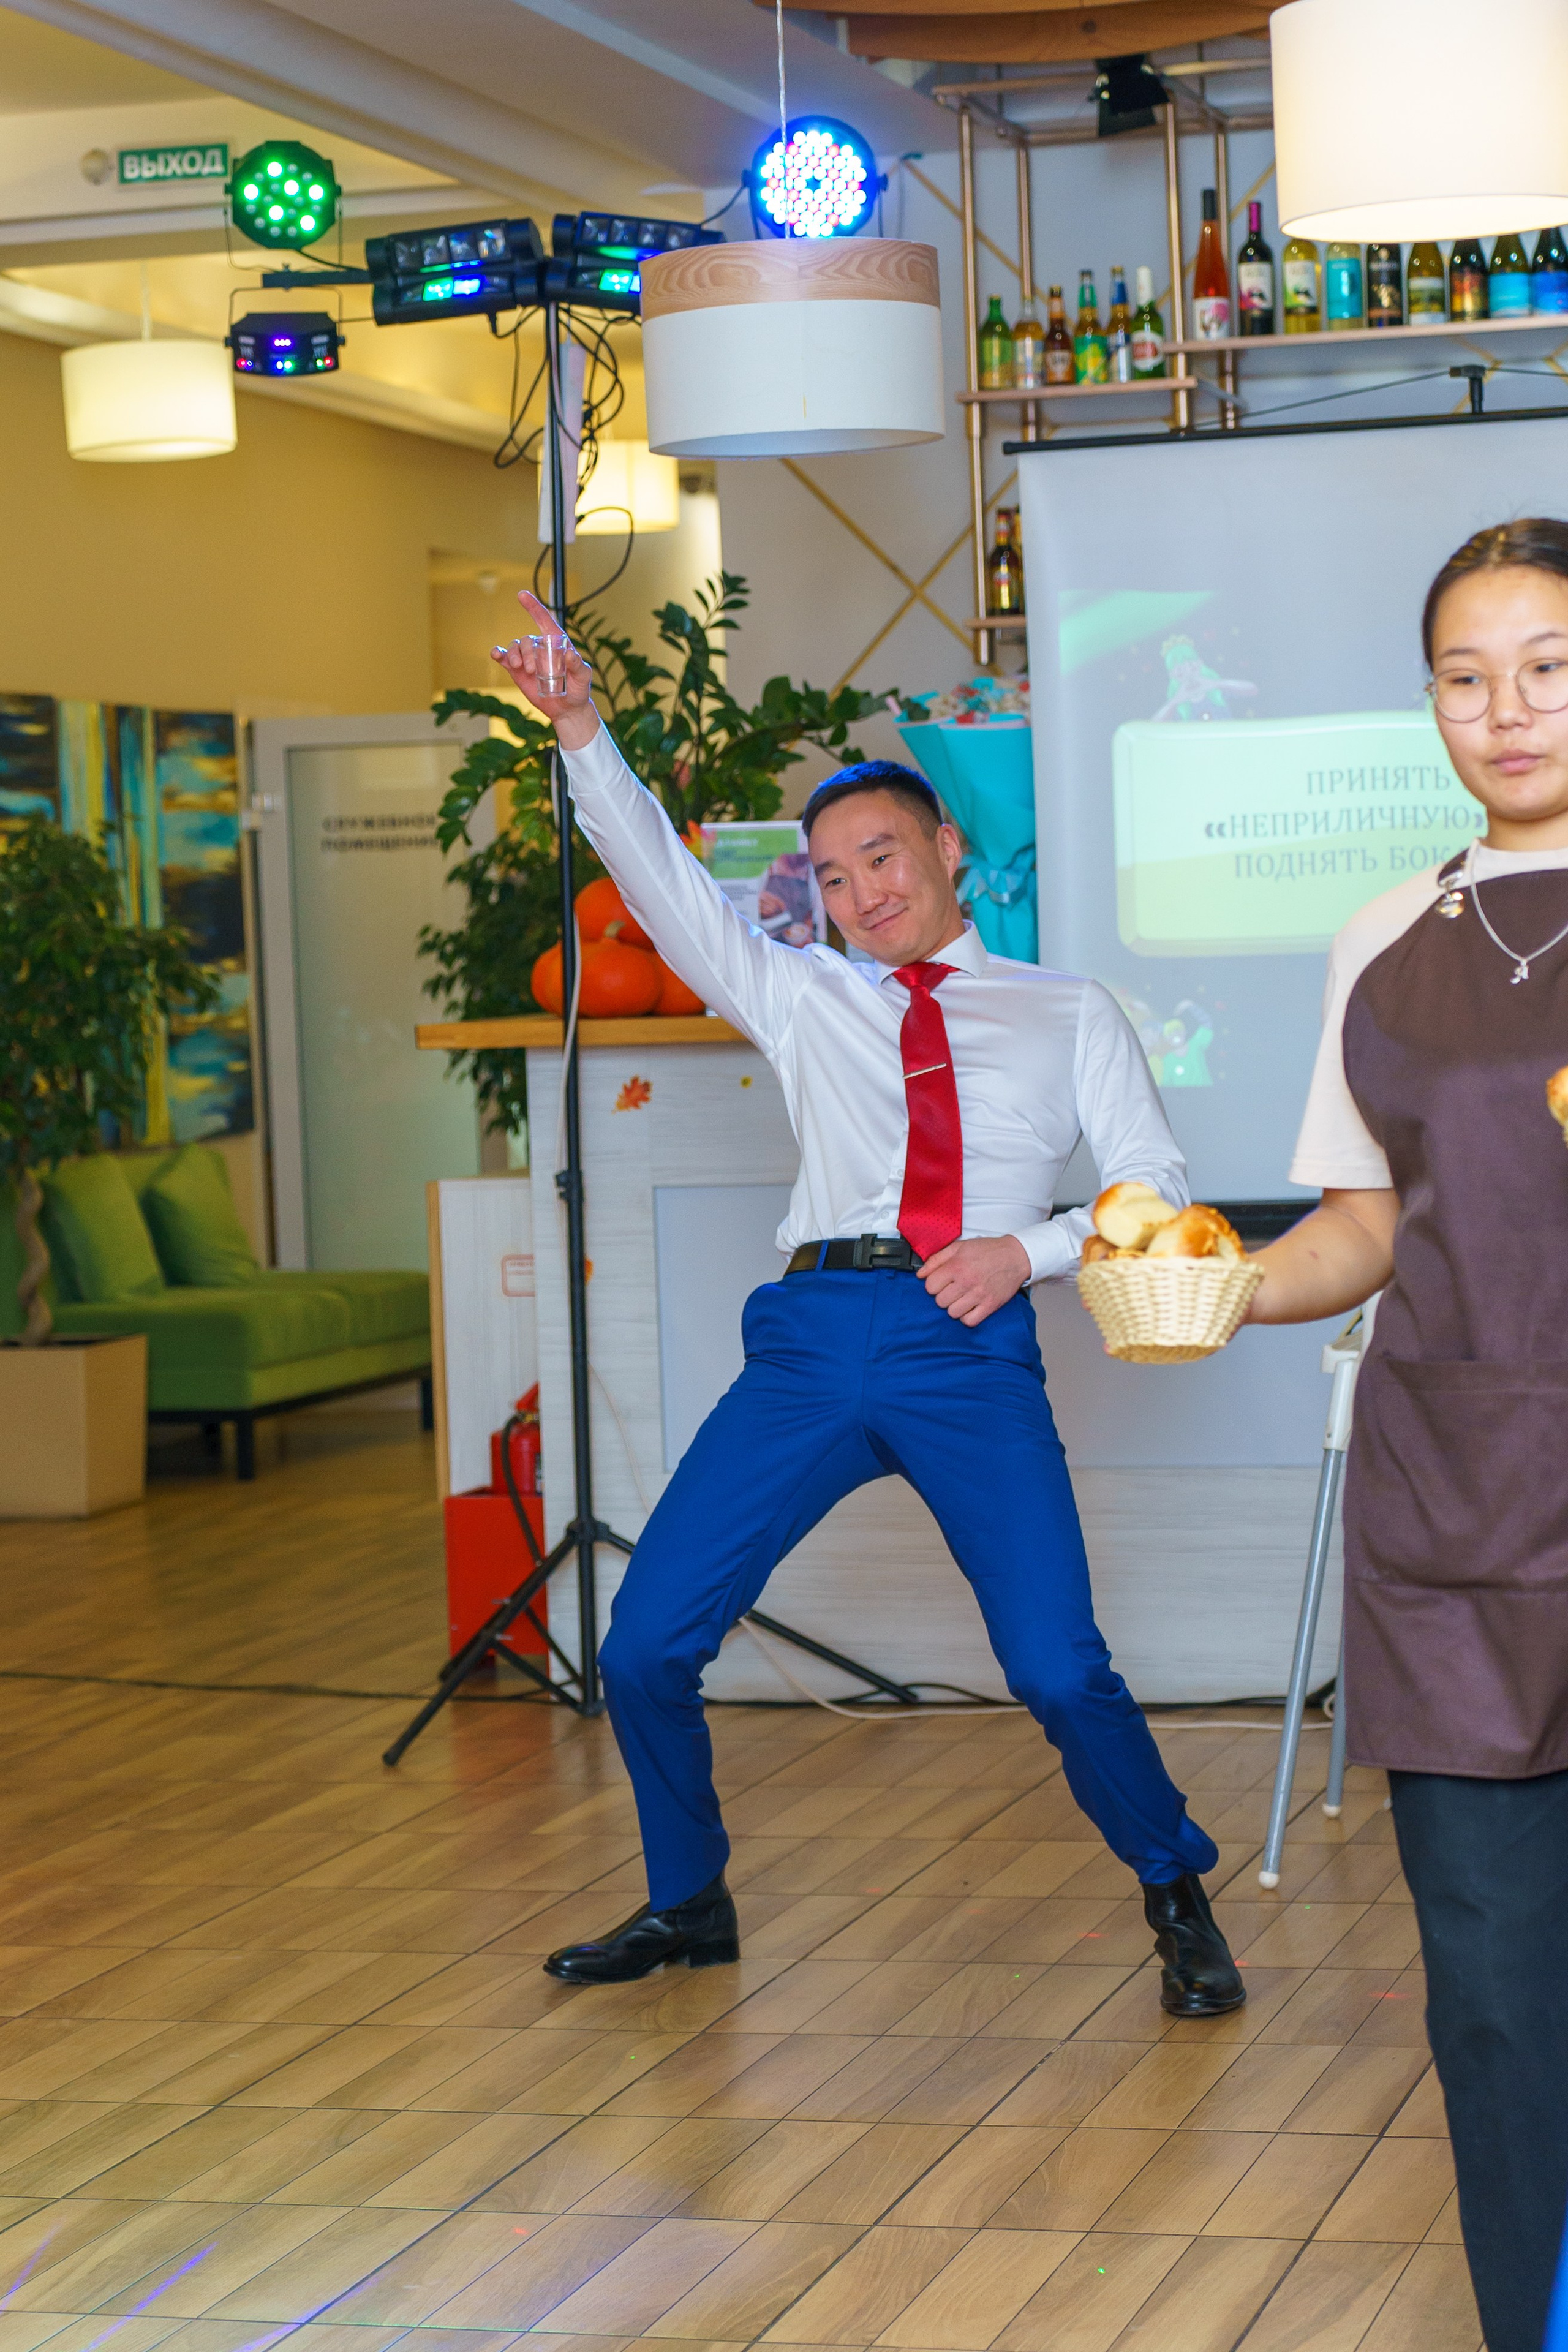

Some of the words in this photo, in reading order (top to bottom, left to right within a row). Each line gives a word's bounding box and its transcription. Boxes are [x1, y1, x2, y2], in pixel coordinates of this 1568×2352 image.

[124, 149, 224, 179] ВЫХОД
[1306, 766, 1452, 796] ПРИНЯТЬ
[1234, 846, 1378, 882] ПОДНЯТЬ
[1389, 844, 1466, 871] БОК
